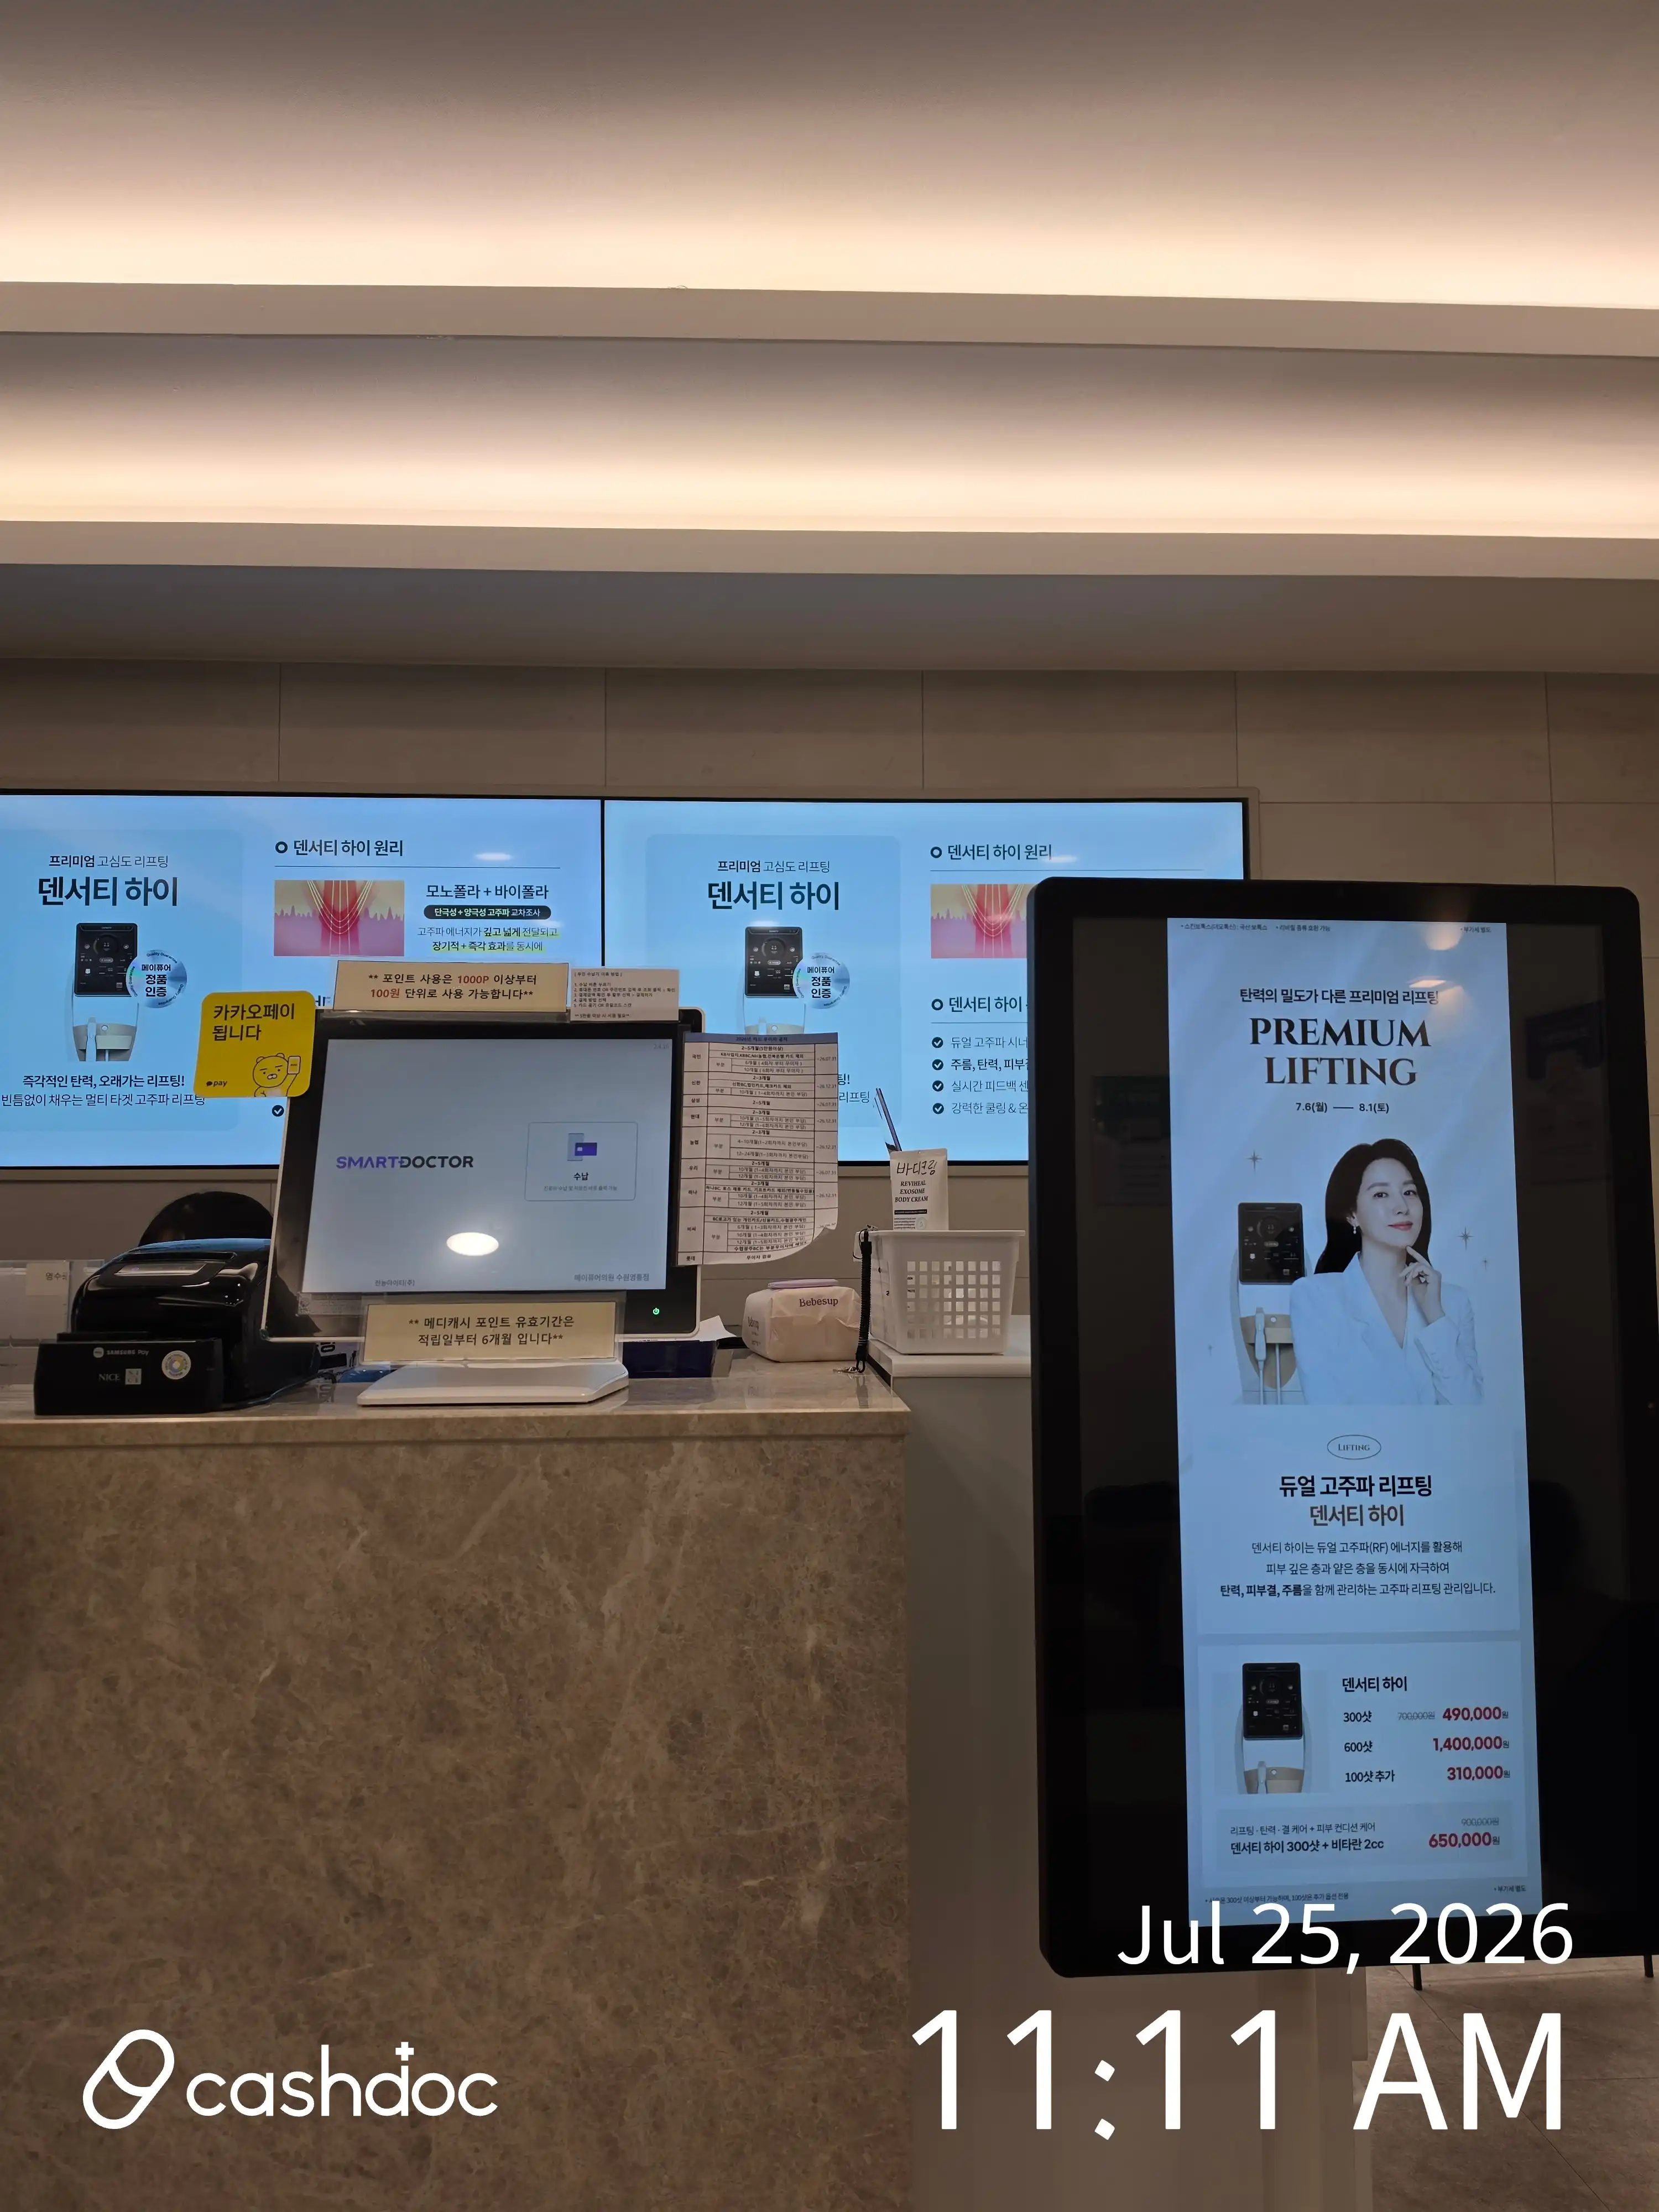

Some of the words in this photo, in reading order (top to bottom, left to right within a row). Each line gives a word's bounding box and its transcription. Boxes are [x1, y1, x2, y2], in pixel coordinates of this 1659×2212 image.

[294, 839, 337, 855] 덴서티
[341, 840, 369, 856] 하이
[374, 840, 402, 856] 원리
[948, 844, 989, 860] 덴서티
[993, 844, 1020, 860] 하이
[1025, 844, 1051, 859] 원리
[49, 855, 94, 867] 프리미엄
[97, 855, 132, 867] 고심도
[135, 856, 168, 868] 리프팅
[718, 860, 760, 872] 프리미엄
[764, 861, 795, 872] 고심도
[799, 861, 829, 873] 리프팅
[39, 877, 117, 906] 덴서티
[125, 877, 177, 906] 하이
[426, 885, 480, 899] 모노폴라
[495, 885, 549, 899] 바이폴라
[708, 881, 782, 910] 덴서티
[790, 882, 838, 910] 하이
[435, 908, 456, 916] 단극성
[465, 908, 486, 916] 양극성
[418, 927, 444, 936] 고주파
[446, 927, 482, 936] 에너지가
[484, 927, 501, 936] 깊고
[504, 927, 520, 937] 넓게
[523, 928, 558, 937] 전달되고
[433, 941, 458, 951] 장기적
[469, 942, 486, 951] 즉각
[488, 941, 513, 951] 효과를
[518, 942, 542, 951] 동시에
[146, 974, 167, 984] 정품
[383, 974, 415, 983] 포인트
[420, 974, 452, 984] 사용은
[494, 975, 536, 984] 이상부터
[145, 987, 166, 997] 인증
[371, 988, 399, 998] 100원
[405, 989, 437, 998] 단위로
[442, 989, 463, 999] 사용
[1240, 988, 1276, 1003] 탄력의
[1281, 989, 1318, 1003] 밀도가
[1322, 989, 1346, 1003] 다른
[1349, 990, 1398, 1004] 프리미엄
[1402, 990, 1438, 1005] 리프팅
[950, 997, 990, 1012] 덴서티
[994, 997, 1021, 1012] 하이
[213, 1003, 294, 1020] 카카오페이
[212, 1025, 261, 1041] 됩니다
[1250, 1018, 1431, 1046] PREMIUM
[952, 1037, 971, 1048] 듀얼
[975, 1037, 1005, 1048] 고주파
[951, 1059, 975, 1071] 주름,
[978, 1059, 1001, 1071] 탄력,
[1265, 1057, 1416, 1086] LIFTING
[23, 1075, 67, 1087] 즉각적인
[71, 1075, 96, 1088] 탄력,
[99, 1075, 144, 1087] 오래가는
[148, 1075, 184, 1087] 리프팅!
[952, 1081, 982, 1092] 실시간
[985, 1081, 1015, 1092] 피드백
[2, 1094, 45, 1106] 빈틈없이
[49, 1094, 82, 1106] 채우는
[86, 1094, 107, 1105] 멀티
[111, 1094, 132, 1105] 타겟
[135, 1094, 169, 1105] 고주파
[171, 1094, 206, 1106] 리프팅
[952, 1103, 983, 1114] 강력한
[987, 1103, 1005, 1114] 쿨링
[1296, 1102, 1327, 1113] 7.6(월)
[1359, 1103, 1389, 1114] 8.1(토)
[800, 1298, 838, 1307] Bebesup
[425, 1317, 469, 1329] 메디캐시
[476, 1317, 510, 1328] 포인트
[515, 1316, 573, 1328] 유효기간은
[419, 1334, 476, 1346] 적립일부터
[482, 1333, 511, 1345] 6개월
[1280, 1475, 1315, 1497] 듀얼
[1320, 1475, 1375, 1496] 고주파
[1379, 1475, 1431, 1496] 리프팅
[1310, 1505, 1363, 1526] 덴서티
[1368, 1505, 1404, 1526] 하이
[1253, 1542, 1281, 1553] 덴서티
[1285, 1542, 1314, 1553] 하이는
[1317, 1542, 1336, 1553] 듀얼
[1339, 1542, 1387, 1554] 고주파(RF)
[1391, 1541, 1430, 1553] 에너지를
[1433, 1541, 1462, 1552] 활용해
[1266, 1563, 1286, 1574] 피부
[1289, 1563, 1308, 1574] 깊은
[1311, 1563, 1331, 1574] 층과
[1333, 1563, 1353, 1574] 얕은
[1356, 1563, 1375, 1574] 층을
[1378, 1563, 1407, 1574] 동시에
[1410, 1562, 1449, 1574] 자극하여
[1221, 1585, 1244, 1598] 탄력,
[1246, 1584, 1280, 1597] 피부결,
[1282, 1584, 1312, 1596] 주름을
[1315, 1584, 1334, 1595] 함께
[1337, 1584, 1377, 1595] 관리하는
[1380, 1584, 1409, 1595] 고주파
[1412, 1583, 1441, 1594] 리프팅
[1444, 1583, 1495, 1594] 관리입니다.
[1343, 1677, 1379, 1692] 덴서티
[1383, 1676, 1407, 1691] 하이
[1344, 1710, 1371, 1722] 300샷
[1443, 1707, 1508, 1721] 490,000원
[1344, 1741, 1373, 1752] 600샷
[1433, 1736, 1509, 1752] 1,400,000원
[1345, 1771, 1373, 1782] 100샷
[1375, 1770, 1395, 1782] 추가
[1447, 1766, 1510, 1781] 310,000원
[1231, 1826, 1254, 1835] 리프팅
[1260, 1825, 1275, 1835] 탄력
[1292, 1824, 1307, 1833] 케어
[1317, 1824, 1333, 1833] 피부
[1335, 1823, 1358, 1833] 컨디션
[1360, 1823, 1375, 1832] 케어
[1231, 1841, 1261, 1854] 덴서티
[1264, 1841, 1284, 1853] 하이
[1287, 1840, 1319, 1851] 300샷
[1332, 1838, 1362, 1851] 비타란
[1364, 1839, 1384, 1849] 2cc
[1429, 1832, 1500, 1848] 650,000원
